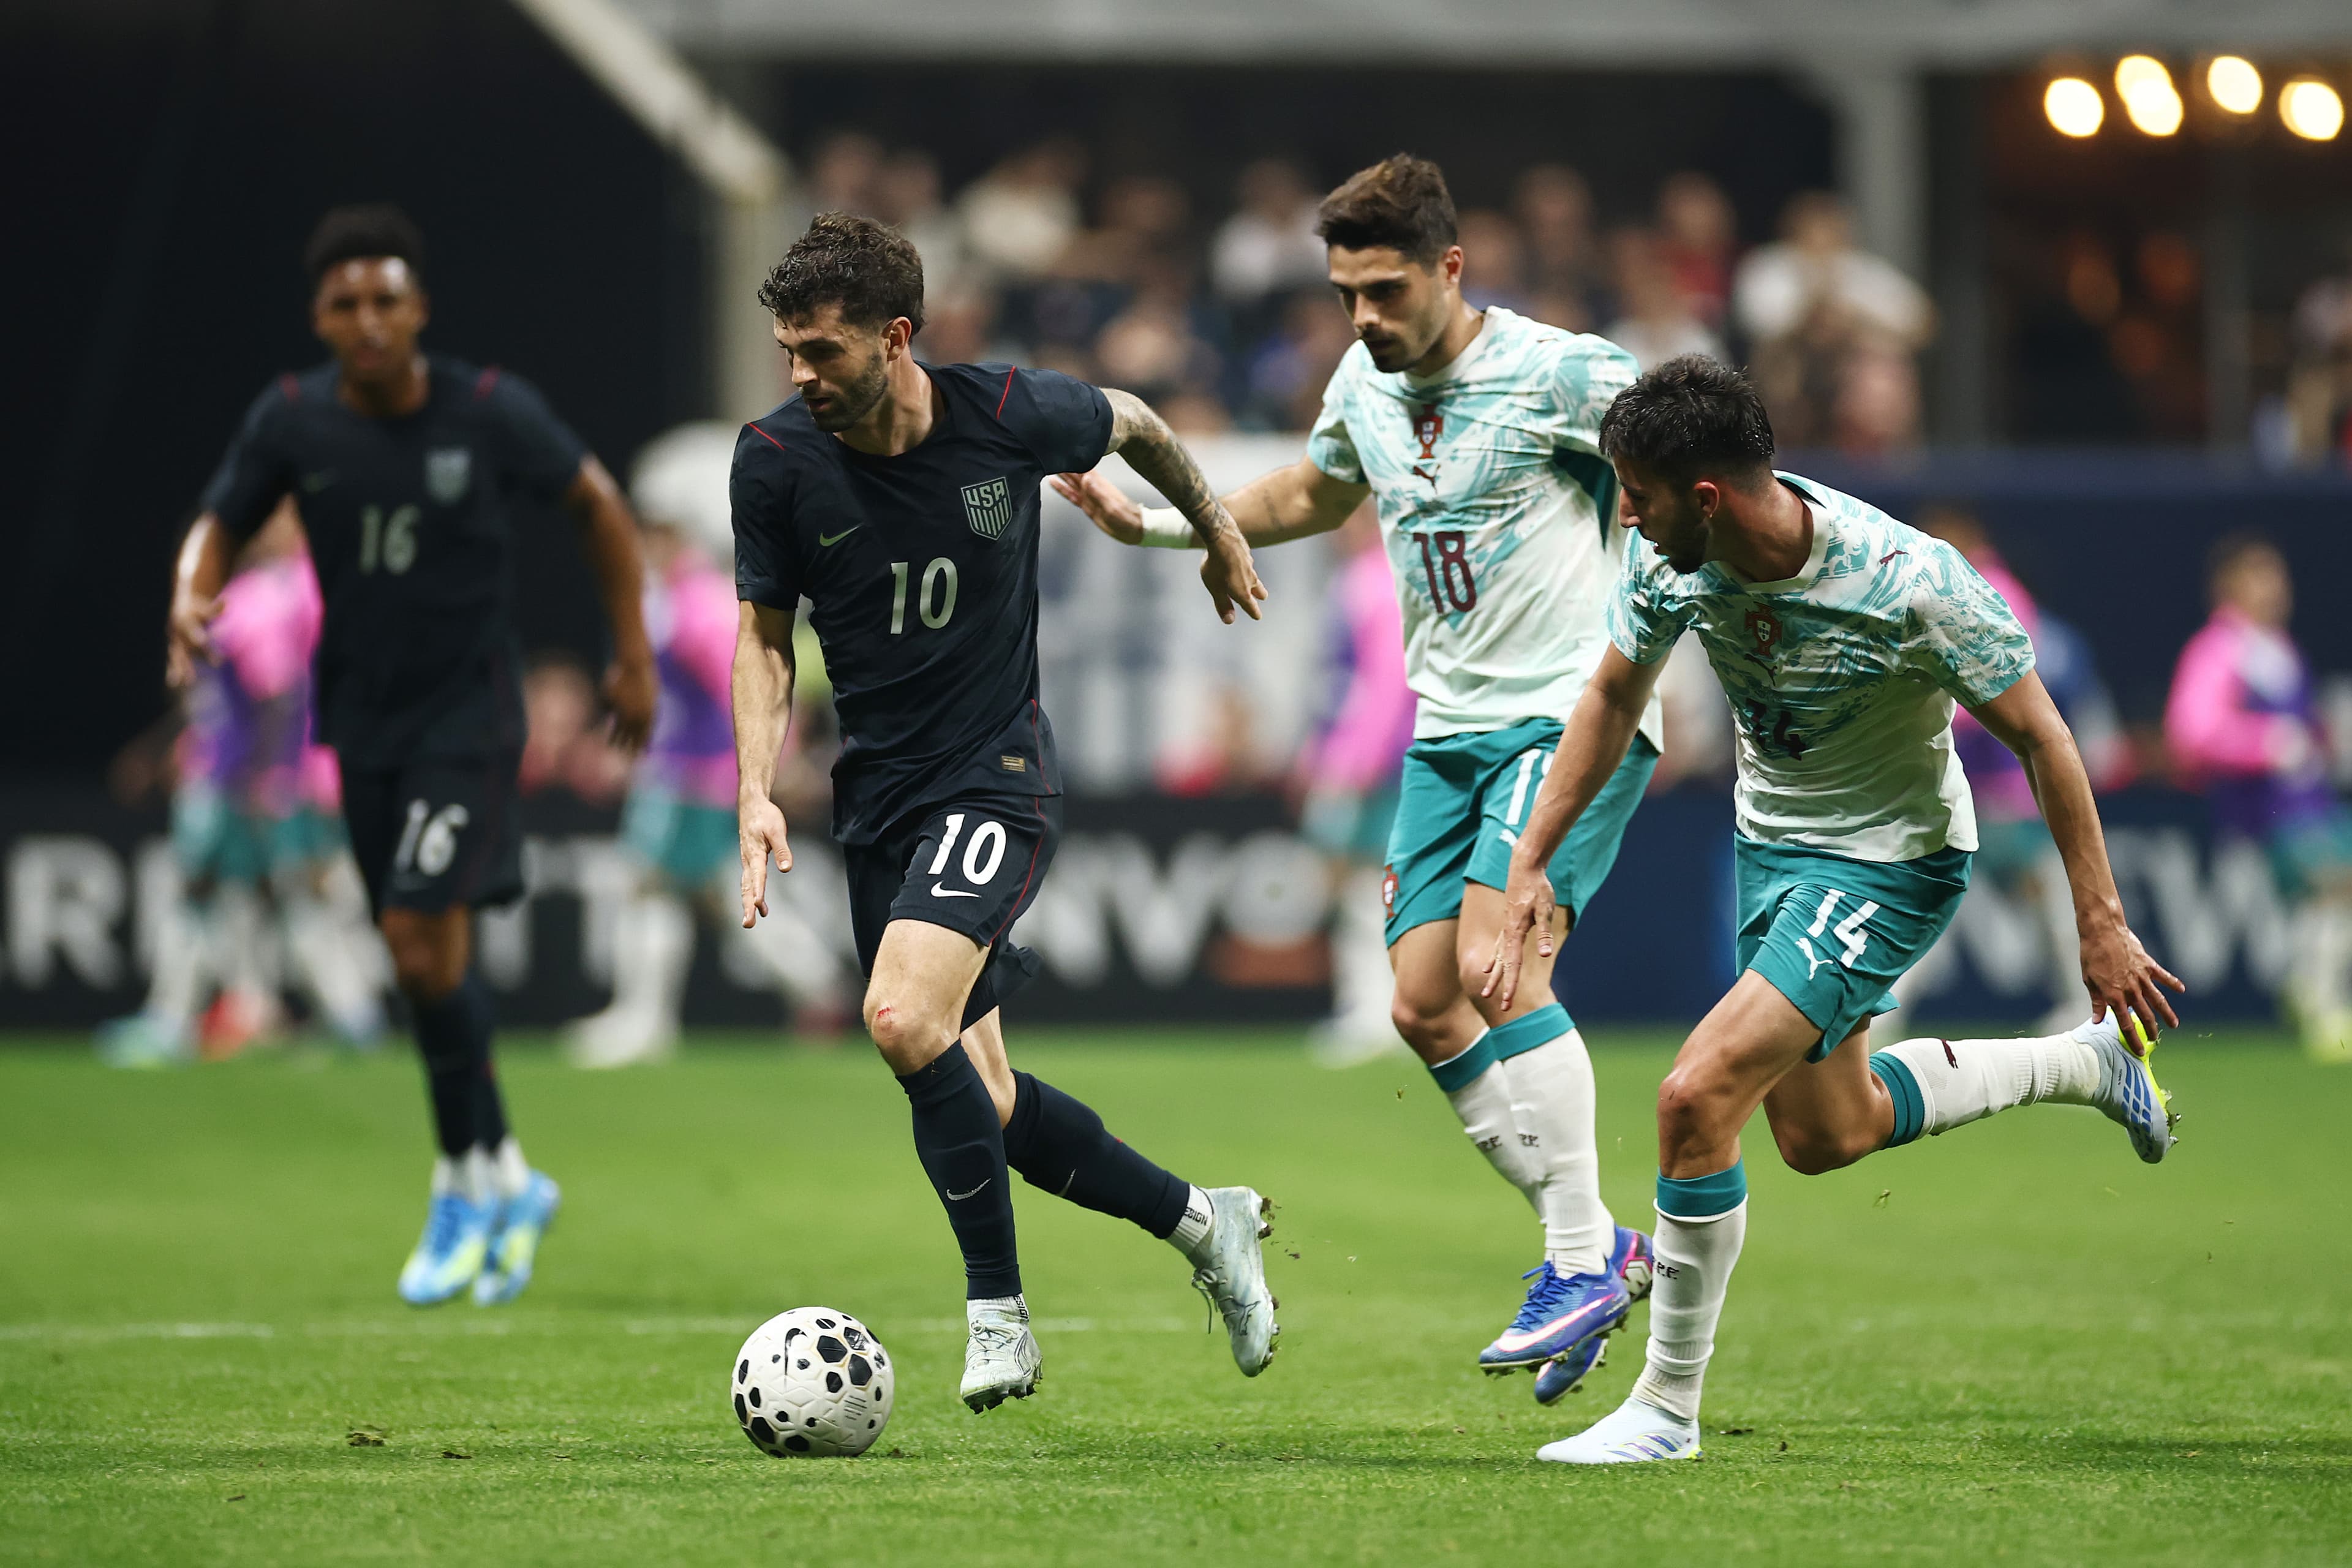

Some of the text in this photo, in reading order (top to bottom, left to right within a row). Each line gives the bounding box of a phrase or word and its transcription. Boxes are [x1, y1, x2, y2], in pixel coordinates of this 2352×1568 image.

[966, 481, 1005, 507] USA
[358, 504, 421, 575] 16
[1413, 530, 1476, 613] 18
[891, 557, 958, 634] 10
[1505, 748, 1555, 826] 1
[393, 798, 469, 876] 16
[927, 813, 1006, 885] 10
[1807, 889, 1880, 968] 14
